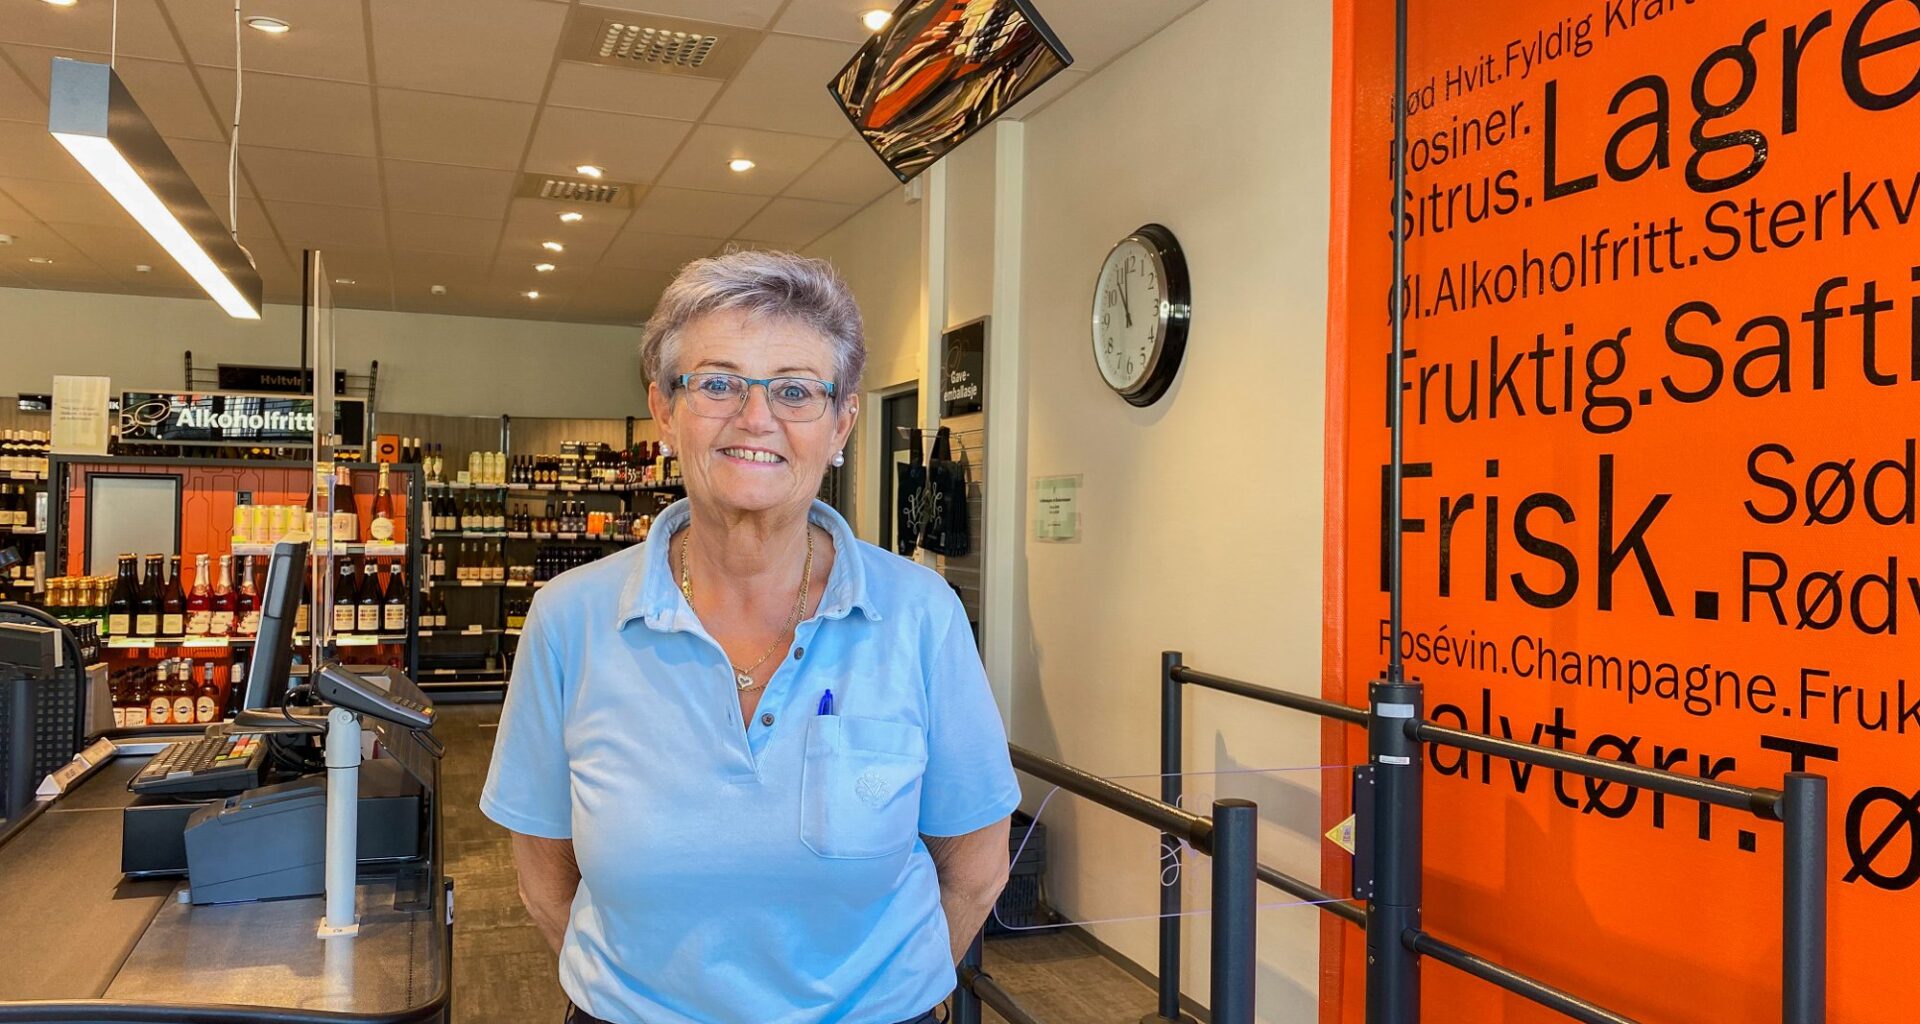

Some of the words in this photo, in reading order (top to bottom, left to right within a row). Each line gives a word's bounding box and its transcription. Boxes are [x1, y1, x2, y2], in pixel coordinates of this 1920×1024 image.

[1605, 0, 1695, 37] Kra
[1543, 0, 1920, 202] Lagre
[1388, 167, 1533, 243] Sitrus.
[1126, 255, 1136, 273] 12
[1140, 259, 1145, 277] 1
[1116, 267, 1124, 284] 11
[1147, 272, 1154, 290] 2
[1107, 290, 1117, 308] 10
[1152, 299, 1159, 317] 3
[1103, 313, 1111, 330] 9
[1147, 325, 1154, 342] 4
[1106, 338, 1114, 354] 8
[1116, 352, 1122, 370] 7
[1140, 347, 1146, 365] 5
[1126, 357, 1134, 374] 6
[950, 370, 970, 384] Gave-
[943, 383, 978, 402] emballasje
[176, 408, 314, 431] Alkoholfritt
[1744, 438, 1916, 527] Sød
[1380, 454, 1719, 621] Frisk.
[1380, 671, 1920, 891] alvtørr.Tø
